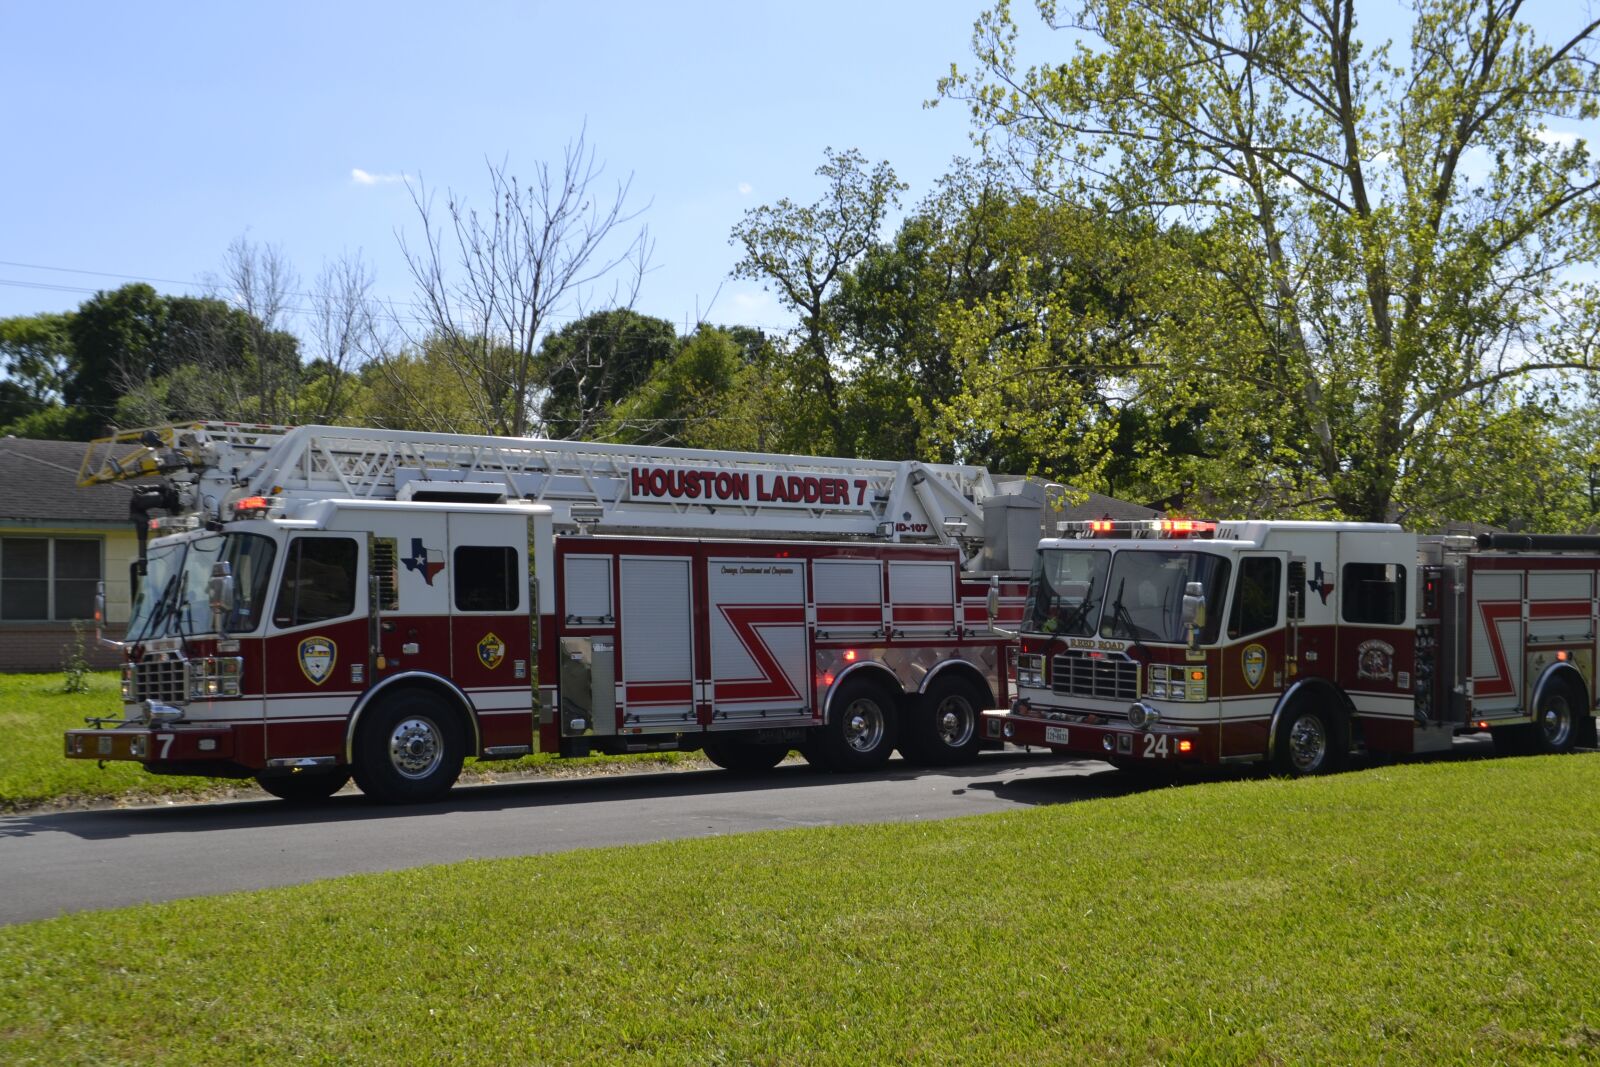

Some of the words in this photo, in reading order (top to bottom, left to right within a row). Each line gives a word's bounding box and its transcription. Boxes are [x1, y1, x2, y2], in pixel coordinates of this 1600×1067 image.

[631, 467, 749, 500] HOUSTON
[756, 474, 850, 505] LADDER
[854, 479, 868, 505] 7
[895, 522, 928, 533] ID-107
[1070, 638, 1096, 649] REED
[1098, 640, 1125, 651] ROAD
[156, 733, 175, 759] 7
[1143, 733, 1169, 759] 24
